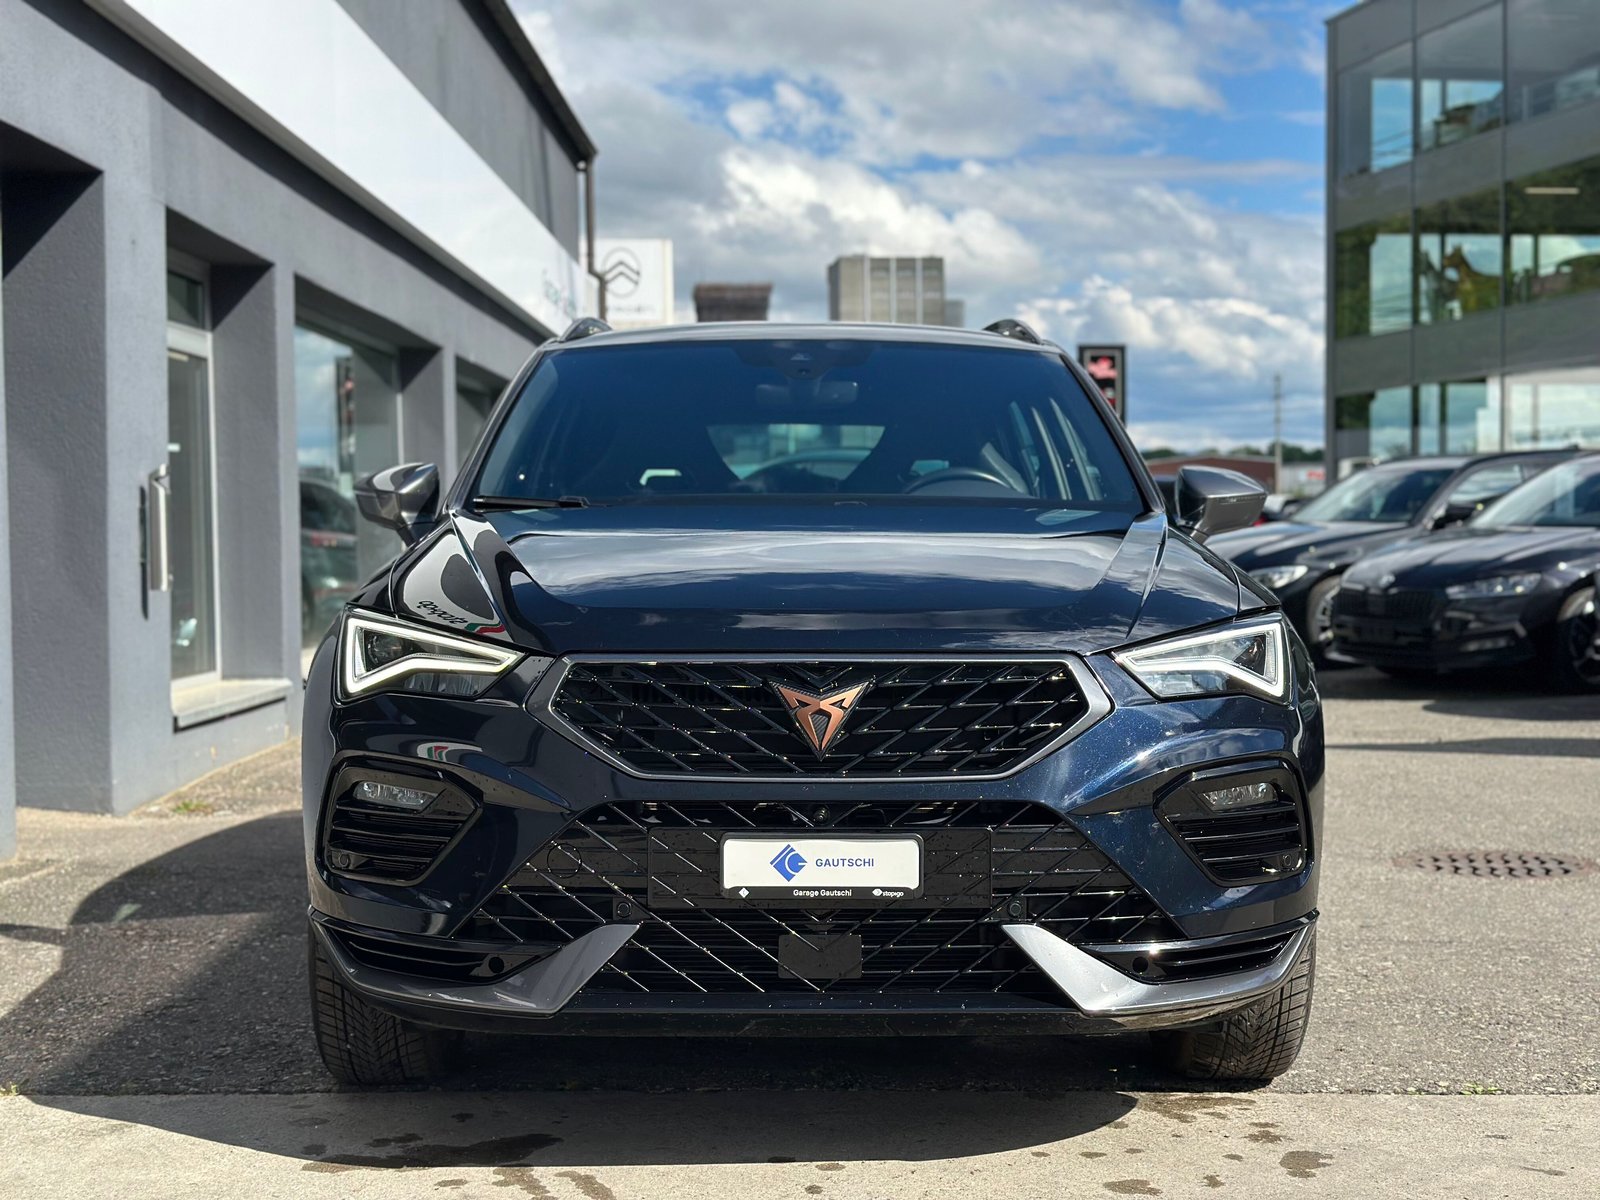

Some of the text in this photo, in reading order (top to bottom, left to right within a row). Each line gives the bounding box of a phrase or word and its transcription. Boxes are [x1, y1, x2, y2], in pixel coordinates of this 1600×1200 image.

[815, 858, 874, 867] GAUTSCHI
[793, 889, 852, 898] Garage Gautschi
